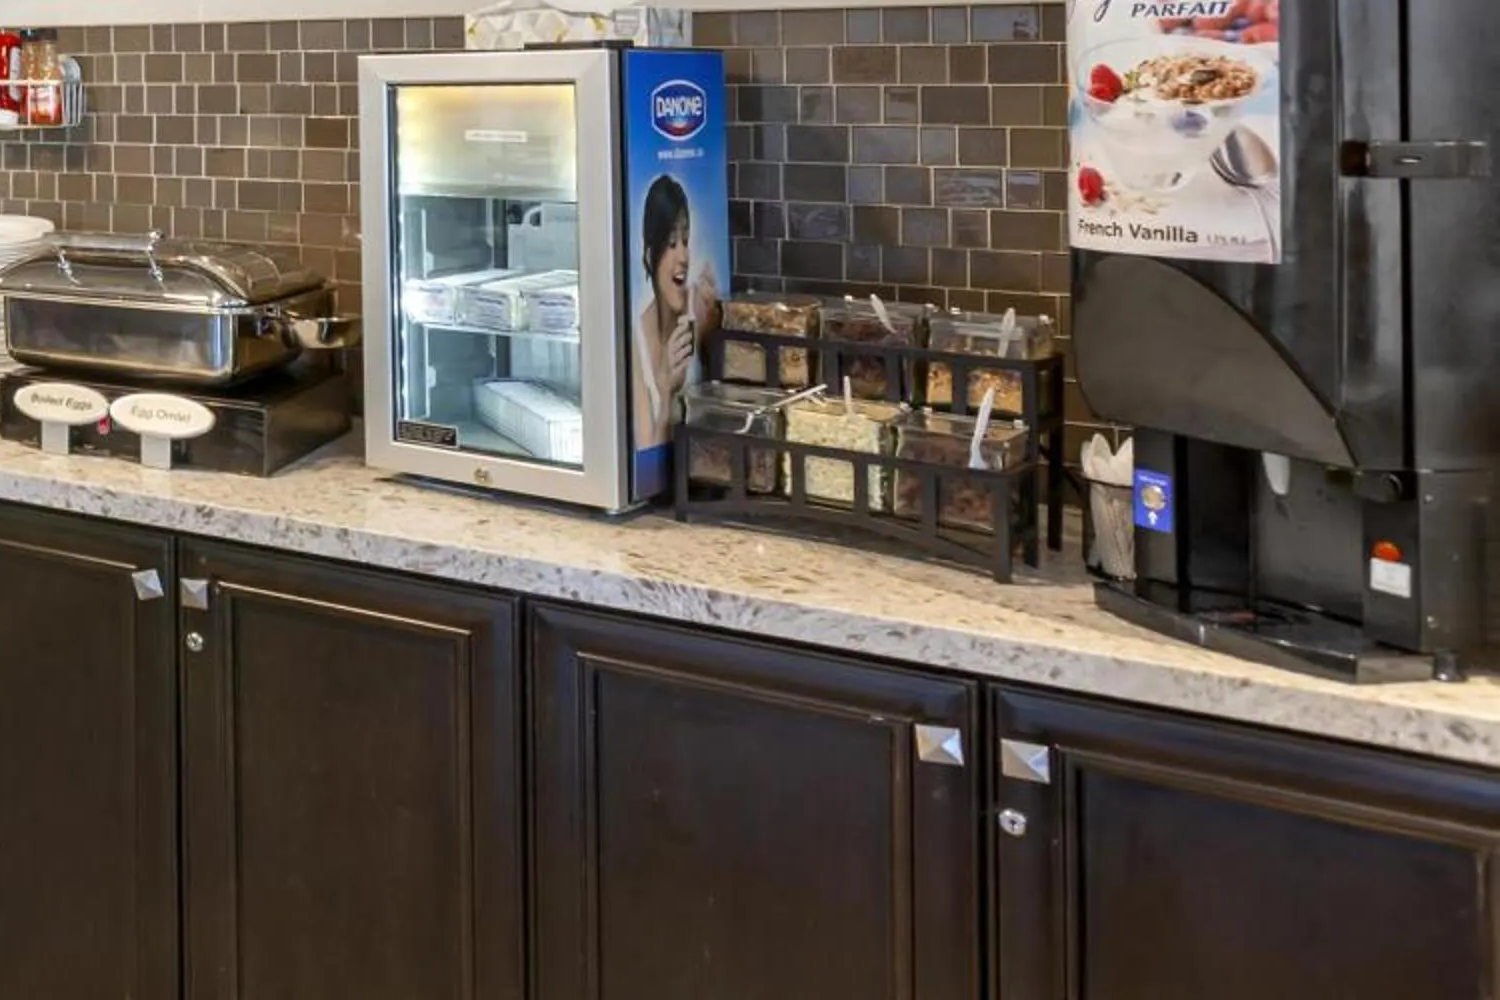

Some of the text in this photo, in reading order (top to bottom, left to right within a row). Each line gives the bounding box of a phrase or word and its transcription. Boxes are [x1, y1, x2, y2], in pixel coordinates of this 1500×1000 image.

[1131, 1, 1230, 18] PARFAIT
[655, 95, 703, 119] DANONE
[1078, 217, 1123, 238] French
[1129, 223, 1199, 244] Vanilla
[131, 405, 151, 421] Egg
